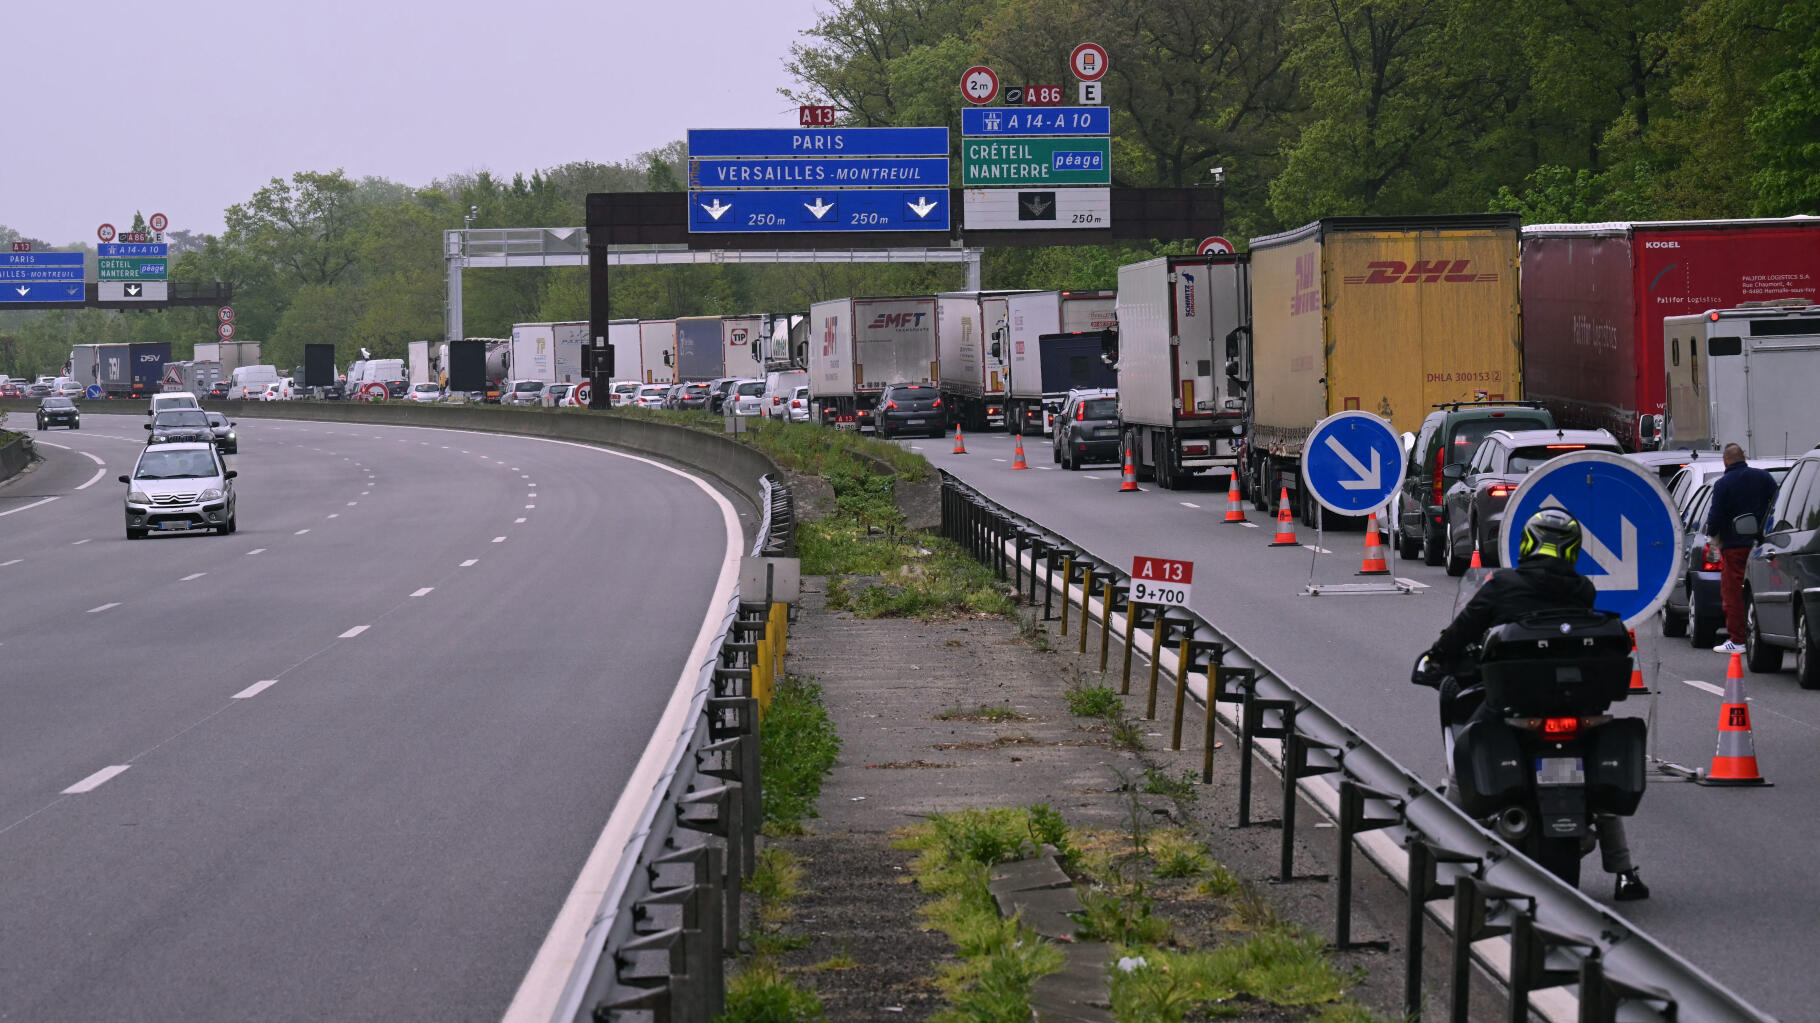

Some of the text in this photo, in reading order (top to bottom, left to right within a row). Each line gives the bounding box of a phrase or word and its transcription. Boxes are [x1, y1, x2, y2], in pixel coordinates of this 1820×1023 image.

[970, 80, 978, 91] 2
[1026, 87, 1061, 102] A 86
[1085, 85, 1095, 101] E
[801, 108, 833, 123] A 13
[1007, 114, 1019, 129] A
[1072, 113, 1091, 128] 10
[792, 135, 845, 150] PARIS
[969, 143, 1033, 159] CRÉTEIL
[1055, 153, 1101, 169] péage
[717, 166, 825, 181] VERSAILLES
[969, 163, 1050, 179] NANTERRE
[747, 213, 787, 226] 250 m
[850, 212, 889, 225] 250 m
[1072, 214, 1093, 224] 250
[128, 233, 145, 241] A 86
[156, 233, 161, 242] E
[13, 243, 30, 251] A 13
[149, 246, 159, 254] 10
[9, 255, 35, 263] PARIS
[100, 260, 131, 268] CRÉTEIL
[100, 269, 139, 277] NANTERRE
[141, 264, 164, 274] péage
[1362, 259, 1475, 285] DHL
[1657, 296, 1722, 304] Palifor Logistics
[732, 333, 746, 342] TIP
[140, 354, 161, 362] DSV
[1426, 373, 1453, 383] DHLA
[1455, 372, 1490, 382] 300153
[1141, 560, 1183, 581] A 13
[1135, 583, 1185, 604] 9+700
